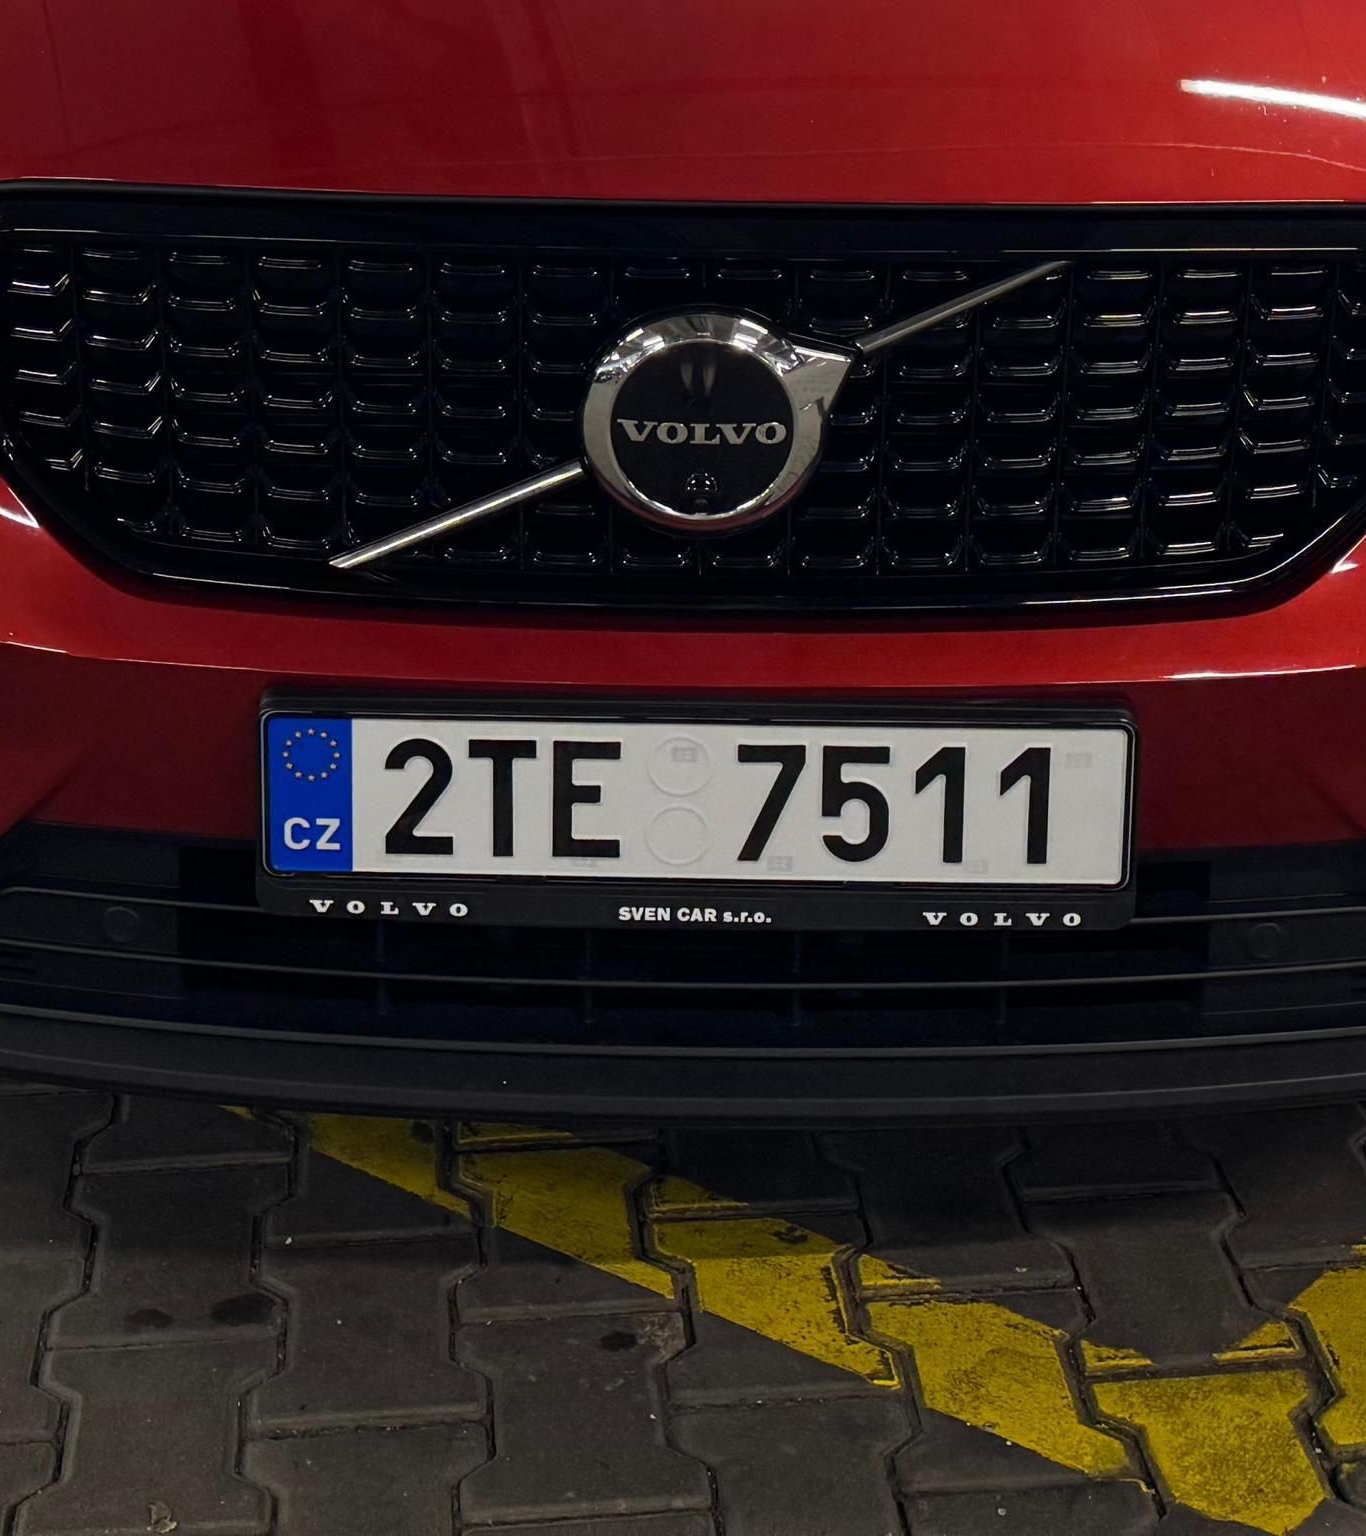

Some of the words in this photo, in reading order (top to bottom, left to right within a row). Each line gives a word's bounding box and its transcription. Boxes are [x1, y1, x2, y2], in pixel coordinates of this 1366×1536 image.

[616, 418, 787, 445] VOLVO
[282, 816, 341, 853] CZ
[383, 737, 622, 859] 2TE
[736, 743, 1052, 864] 7511
[309, 898, 469, 918] VOLVO
[618, 906, 671, 922] SVEN
[676, 907, 718, 923] CAR
[722, 910, 772, 924] s.r.o.
[922, 911, 1082, 928] VOLVO
